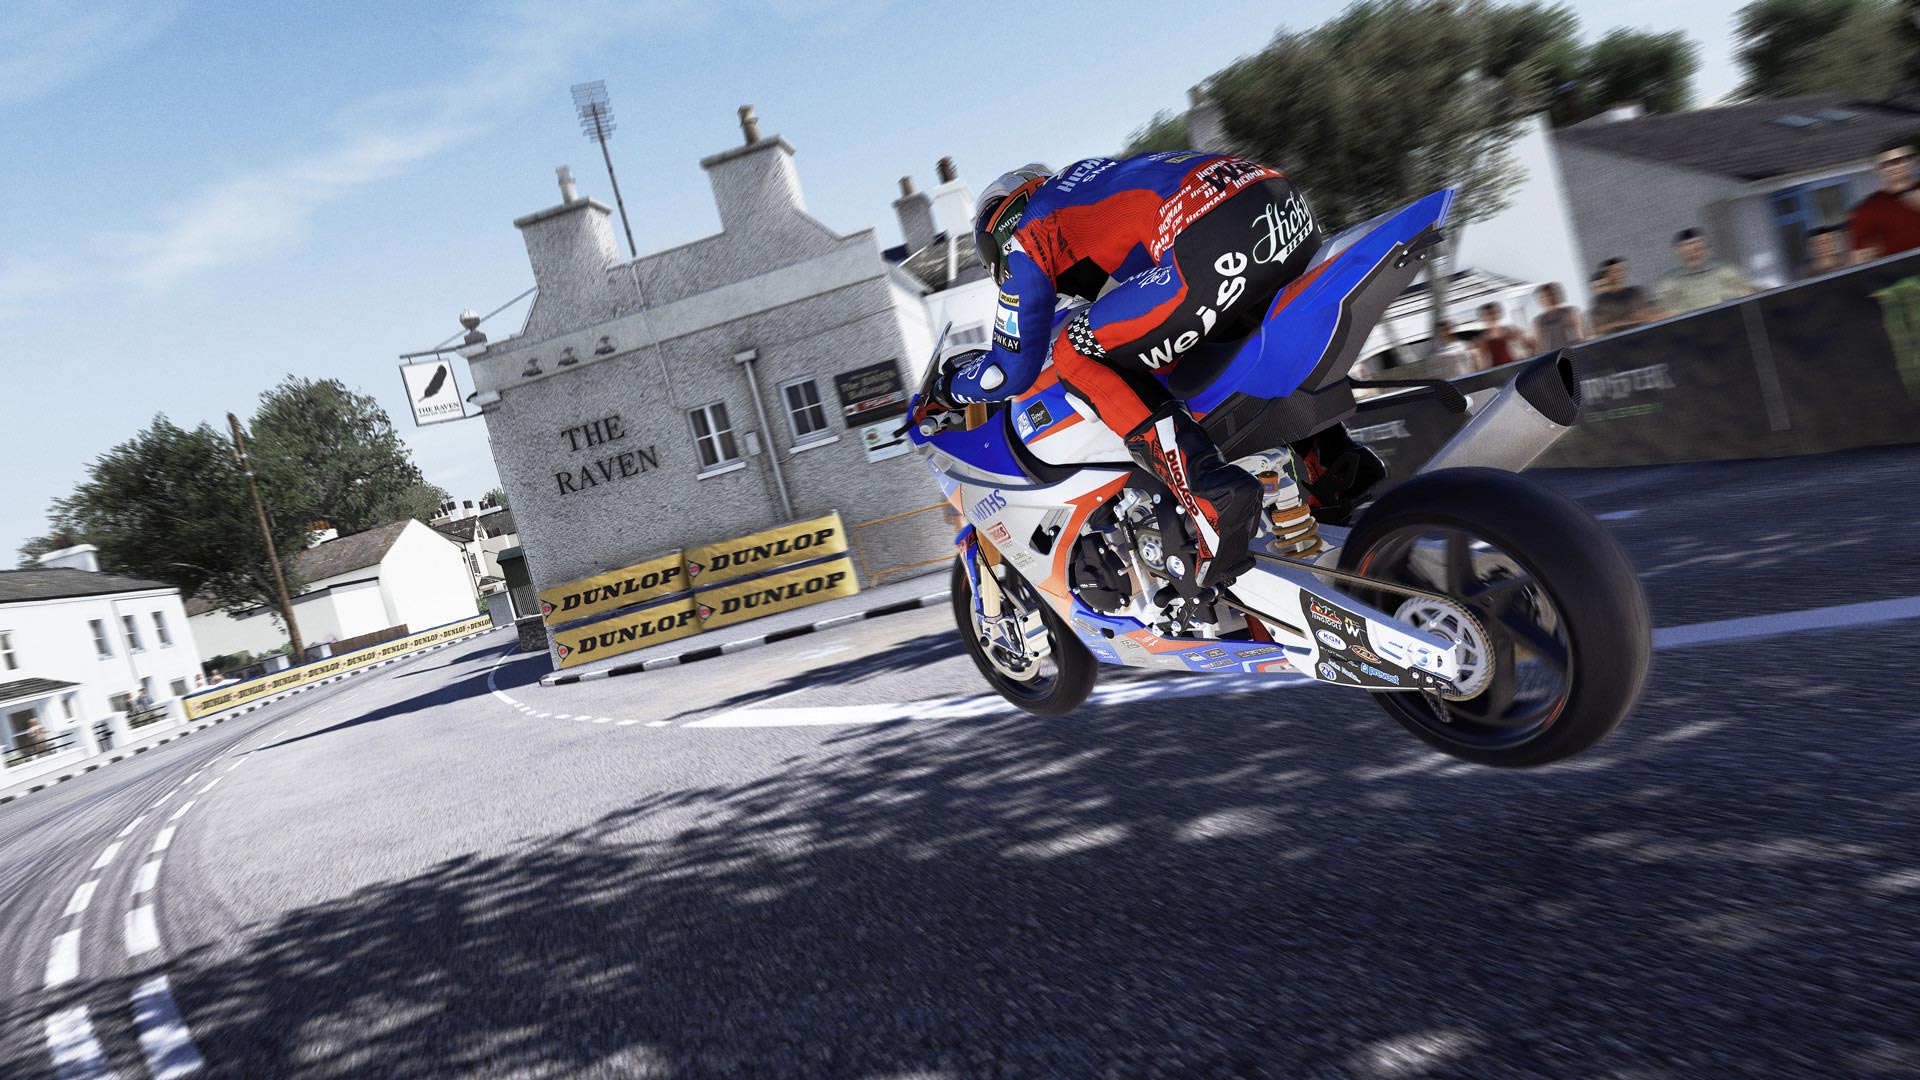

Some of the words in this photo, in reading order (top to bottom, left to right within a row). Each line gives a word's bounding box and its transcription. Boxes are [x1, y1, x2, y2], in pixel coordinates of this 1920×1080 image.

[561, 415, 624, 452] THE
[554, 445, 660, 496] RAVEN
[710, 527, 835, 572] DUNLOP
[561, 565, 682, 611] DUNLOP
[720, 571, 847, 615] DUNLOP
[347, 651, 376, 666] DUNLOP
[382, 641, 409, 656] DUNLOP
[414, 633, 438, 647] DUNLOP
[443, 625, 466, 638] DUNLOP
[577, 609, 696, 654] DUNLOP
[1323, 633, 1341, 645] KGN
[1369, 666, 1399, 685] prevost
